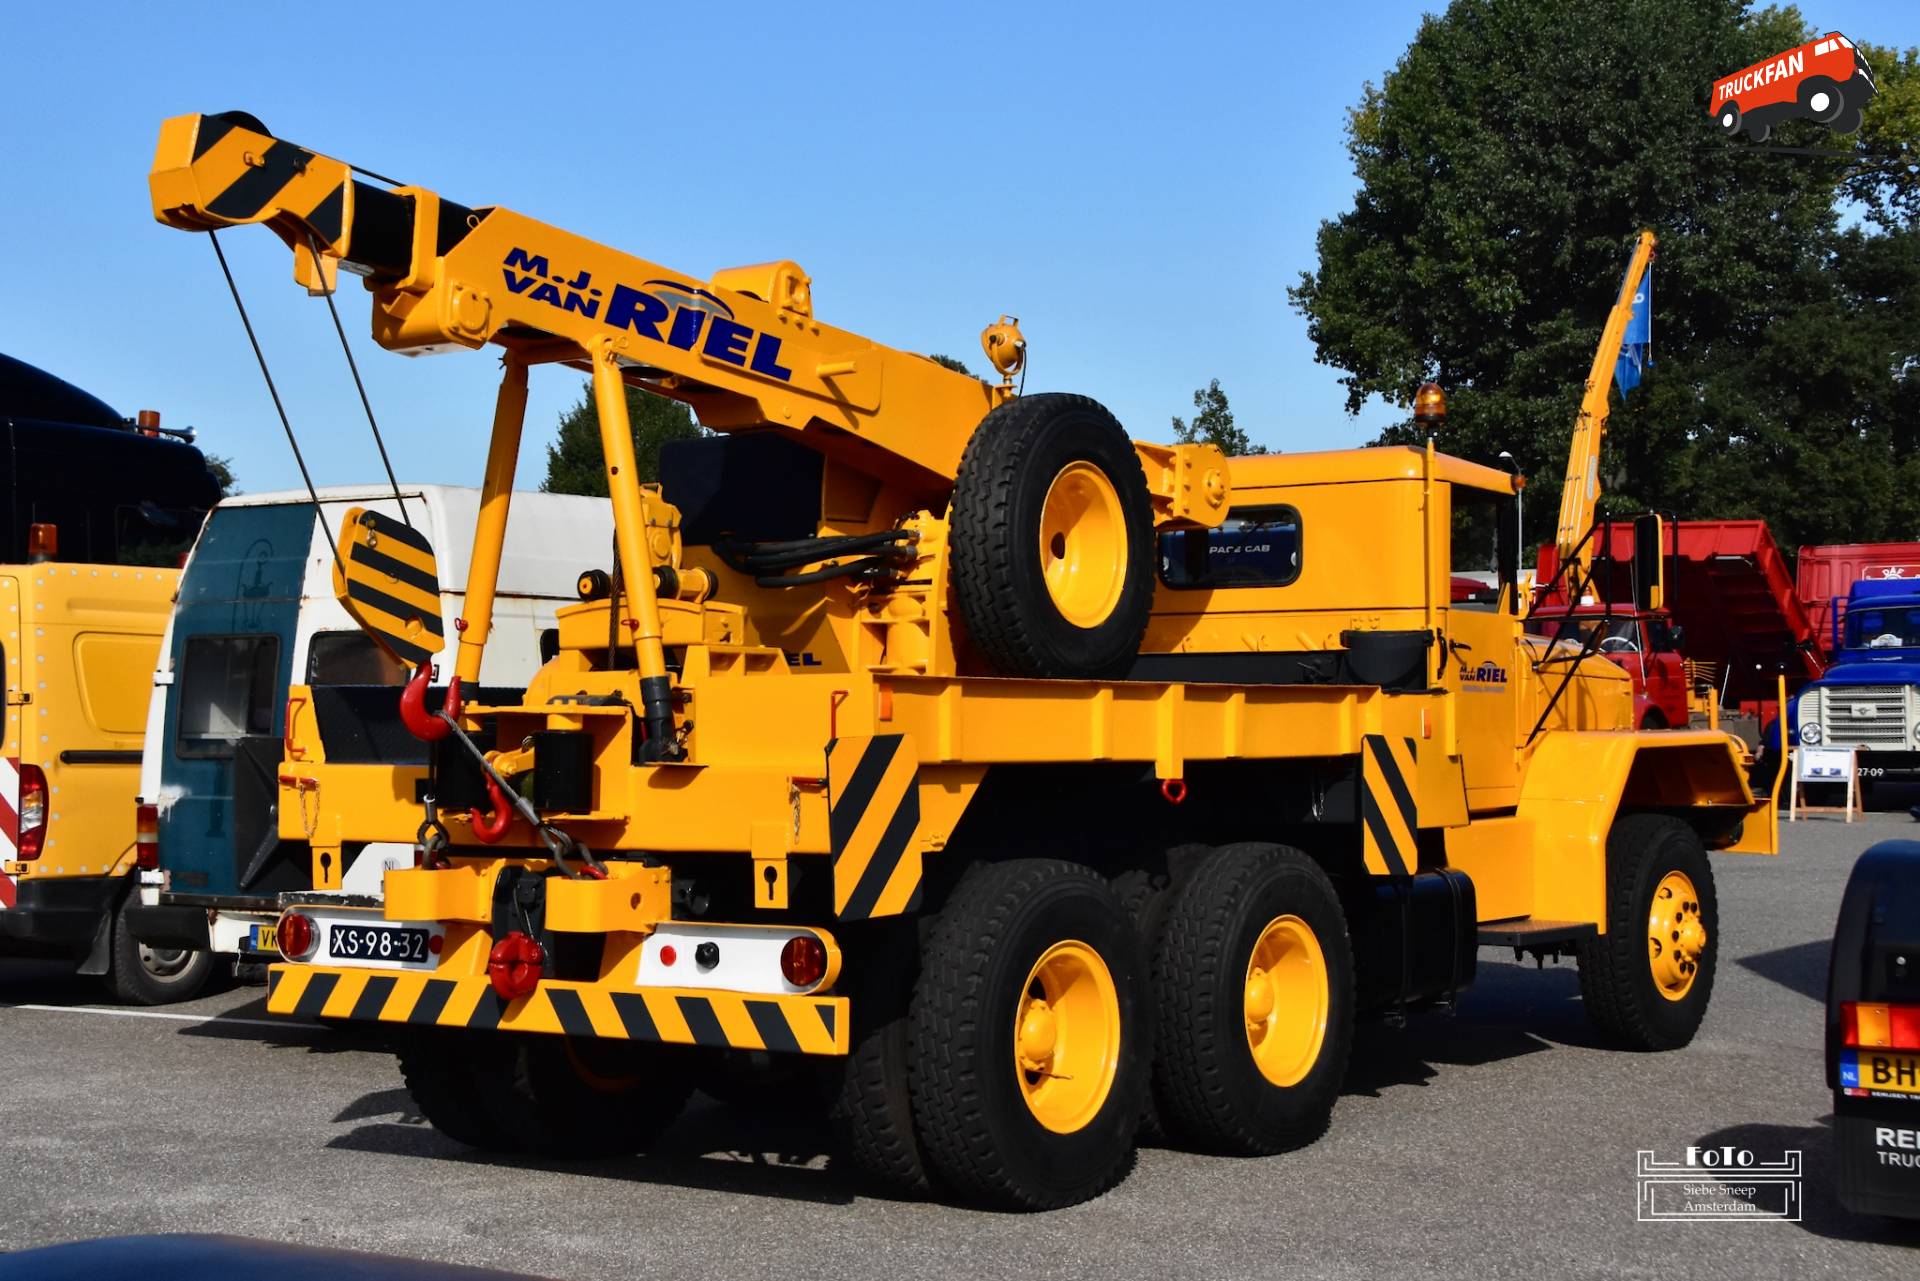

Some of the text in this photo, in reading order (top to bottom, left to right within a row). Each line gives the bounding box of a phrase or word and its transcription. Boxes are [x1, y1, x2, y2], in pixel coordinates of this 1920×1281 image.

[503, 247, 602, 297] M.J.
[502, 268, 792, 382] VAN RIEL
[1477, 668, 1507, 682] RIEL
[332, 929, 423, 958] XS-98-32
[1876, 1127, 1920, 1149] RE
